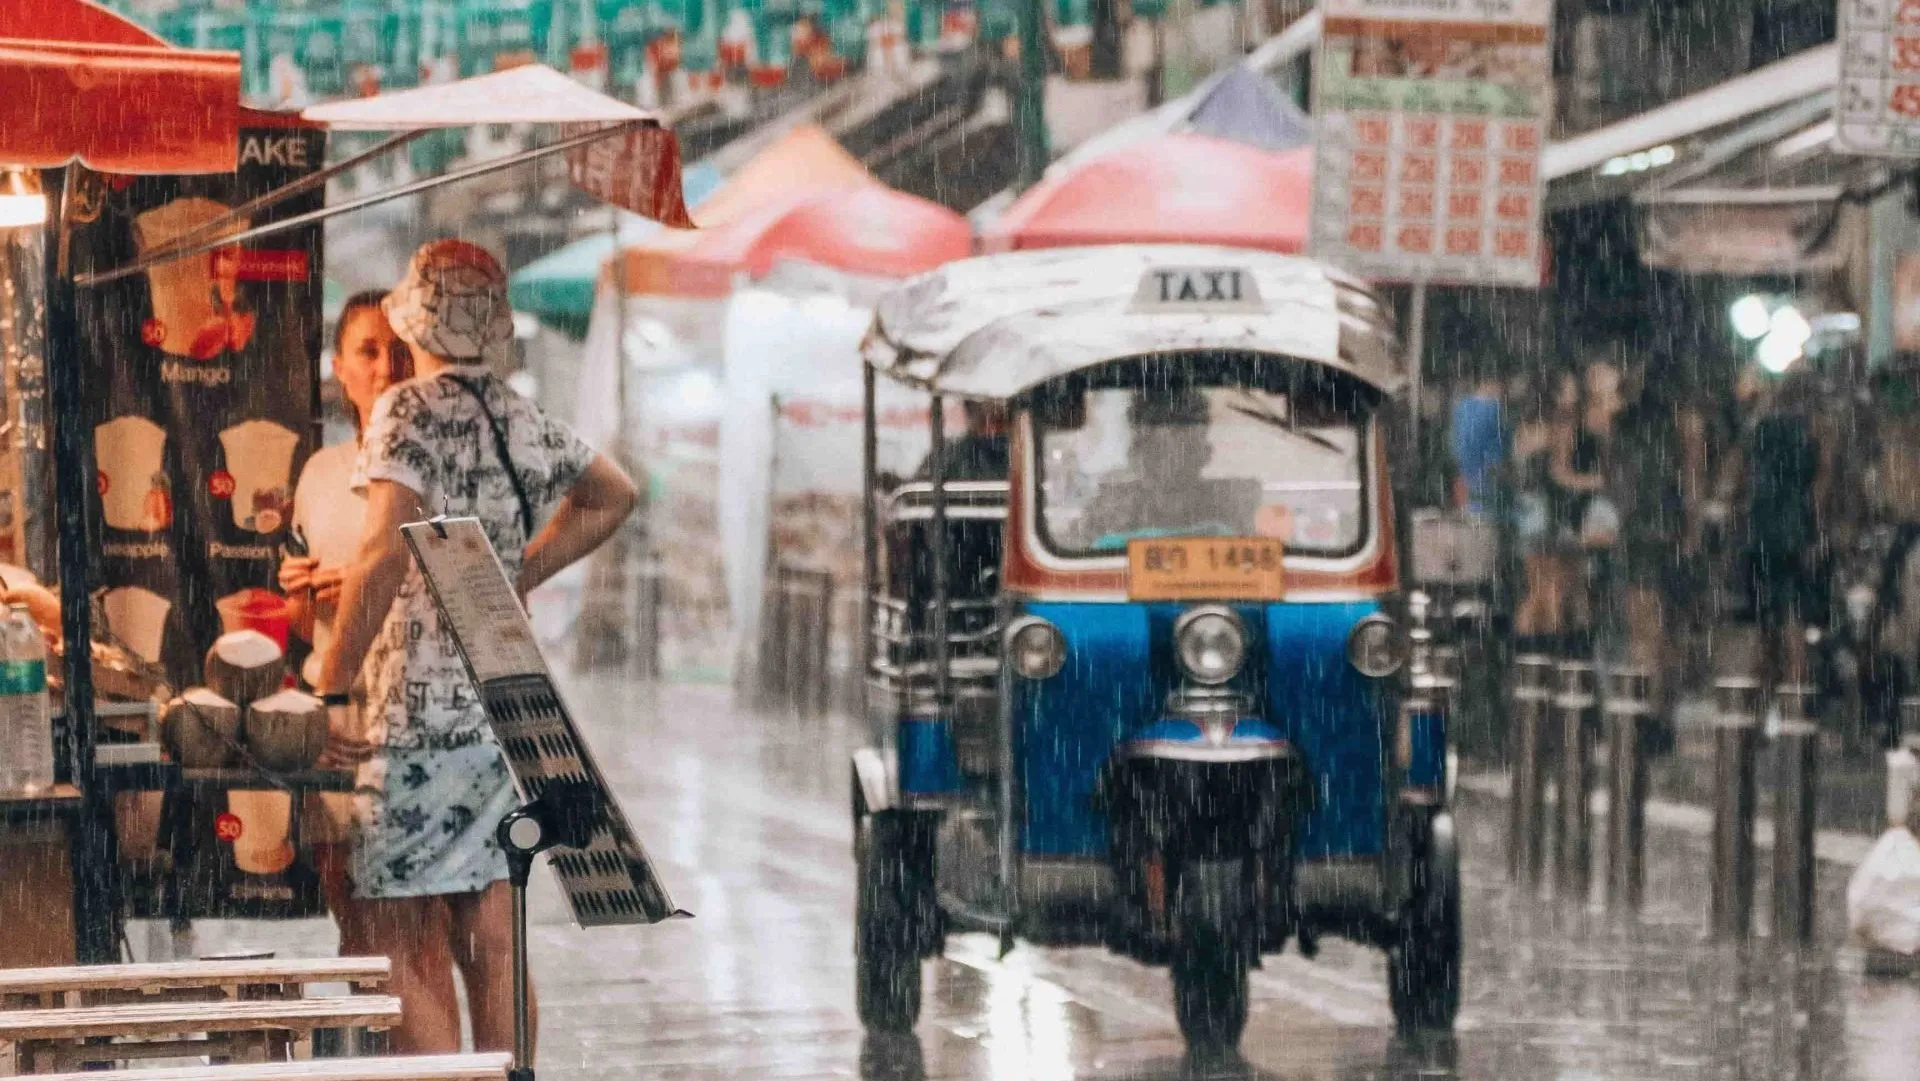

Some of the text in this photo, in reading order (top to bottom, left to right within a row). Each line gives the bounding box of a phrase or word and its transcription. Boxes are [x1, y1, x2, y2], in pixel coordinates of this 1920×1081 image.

[240, 136, 307, 166] AKE
[1153, 271, 1242, 301] TAXI
[161, 361, 230, 386] Mango
[209, 541, 272, 559] Passion
[219, 820, 241, 836] 50
